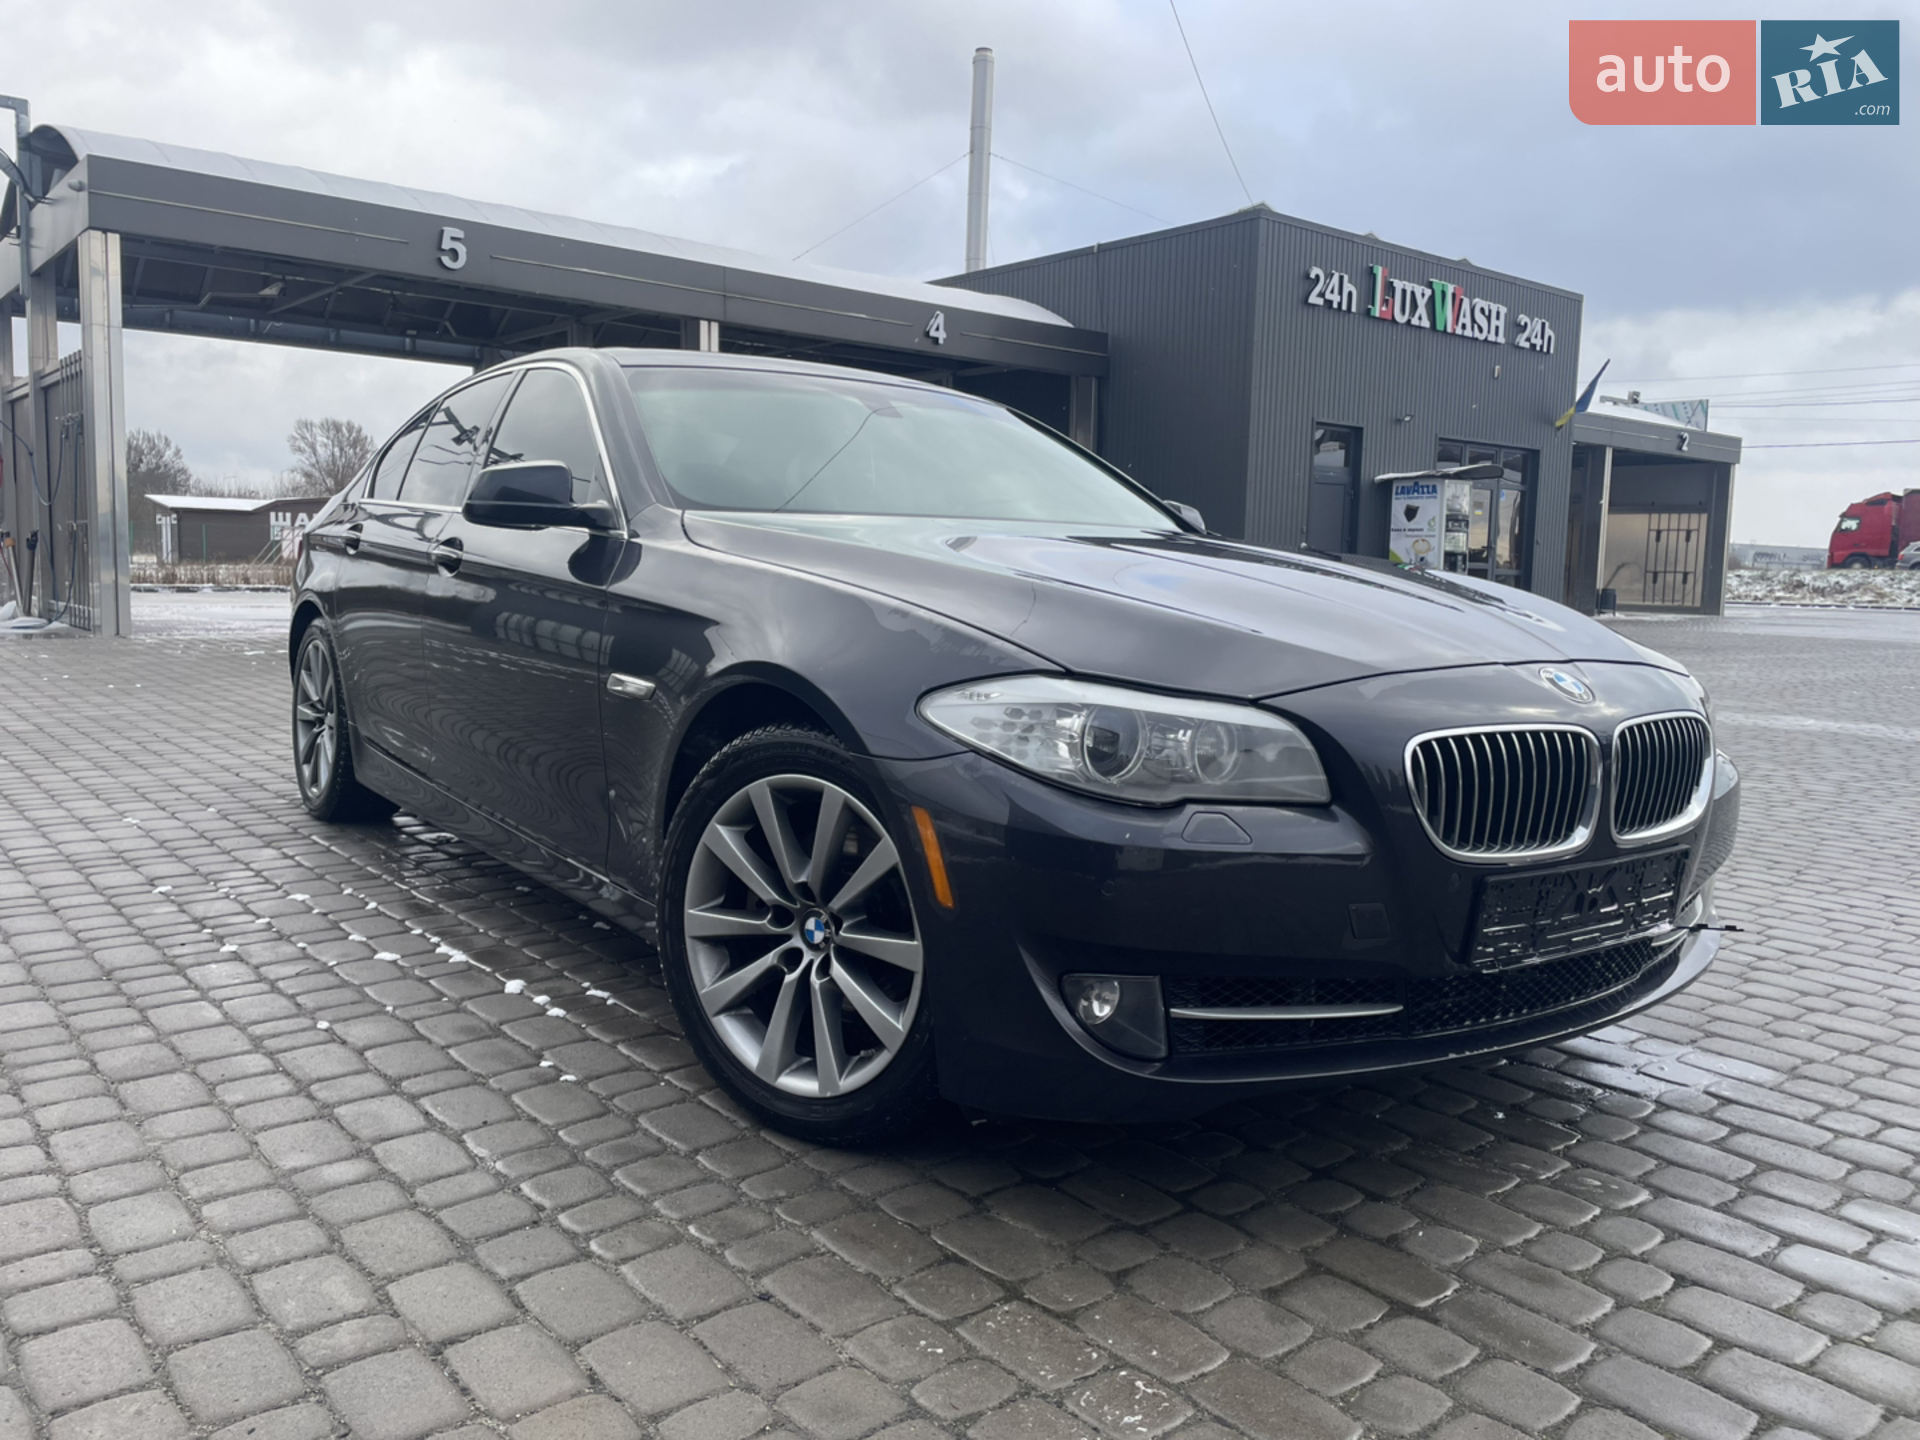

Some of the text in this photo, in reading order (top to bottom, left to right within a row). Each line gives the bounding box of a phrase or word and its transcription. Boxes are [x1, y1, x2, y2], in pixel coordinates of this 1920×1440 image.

[440, 226, 467, 270] 5
[926, 310, 947, 345] 4
[1307, 266, 1357, 313] 24h
[1515, 314, 1555, 354] 24h
[1679, 431, 1690, 451] 2
[1395, 481, 1437, 495] LAVAZZA
